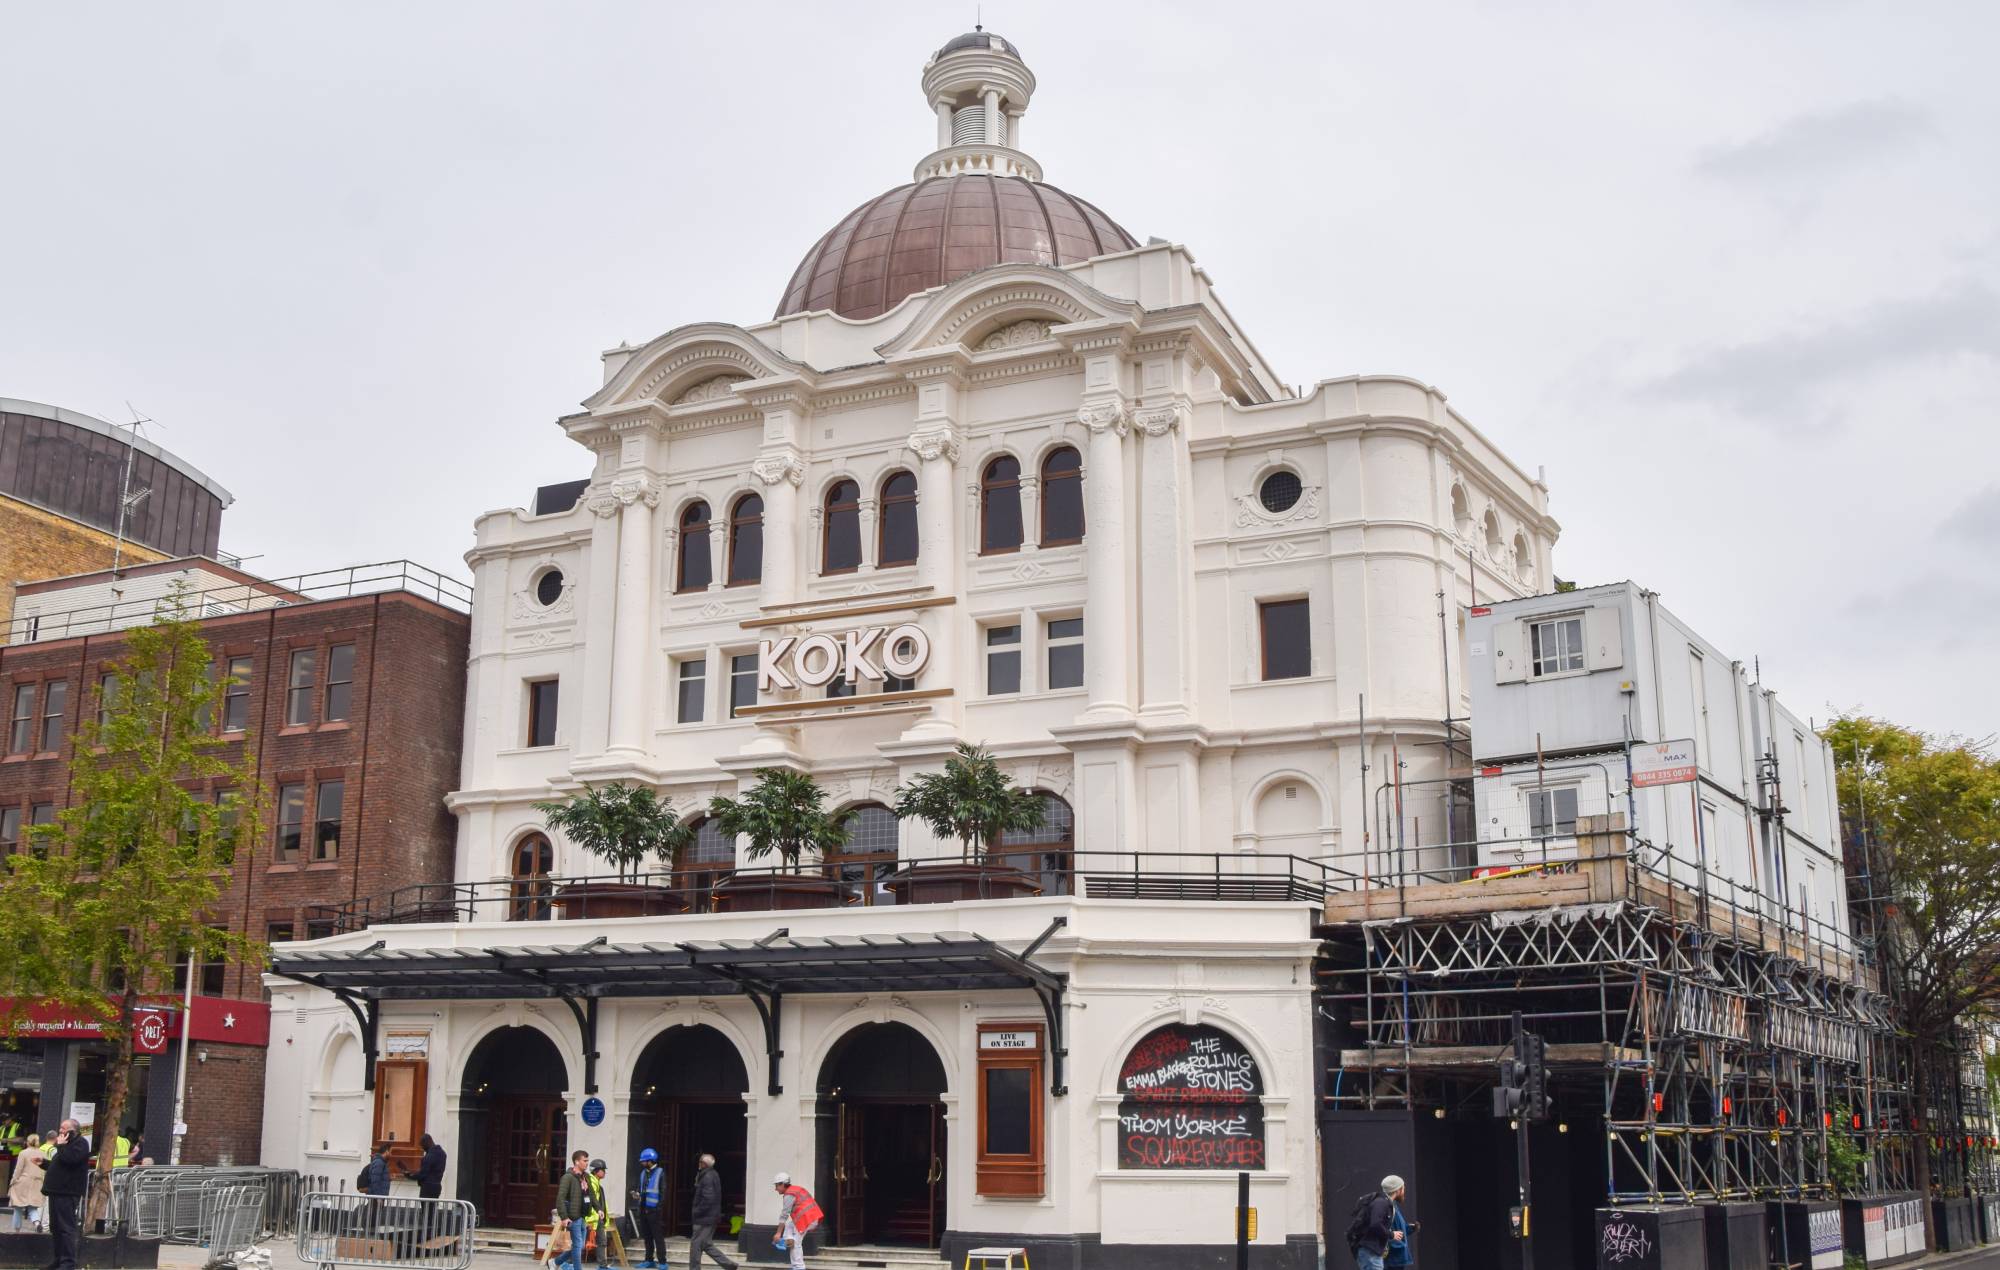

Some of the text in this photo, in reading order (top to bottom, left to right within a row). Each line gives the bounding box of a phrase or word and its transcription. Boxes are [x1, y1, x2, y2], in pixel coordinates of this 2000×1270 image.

[759, 623, 930, 690] KOKO
[145, 1025, 161, 1039] PRET
[990, 1040, 1026, 1048] ON STAGE
[1191, 1038, 1221, 1054] THE
[1187, 1052, 1255, 1070] ROLLING
[1126, 1073, 1157, 1089] EMMA
[1186, 1069, 1254, 1091] STONES
[1121, 1114, 1171, 1135] THOM
[1128, 1135, 1264, 1167] SQUAREPUSHER
